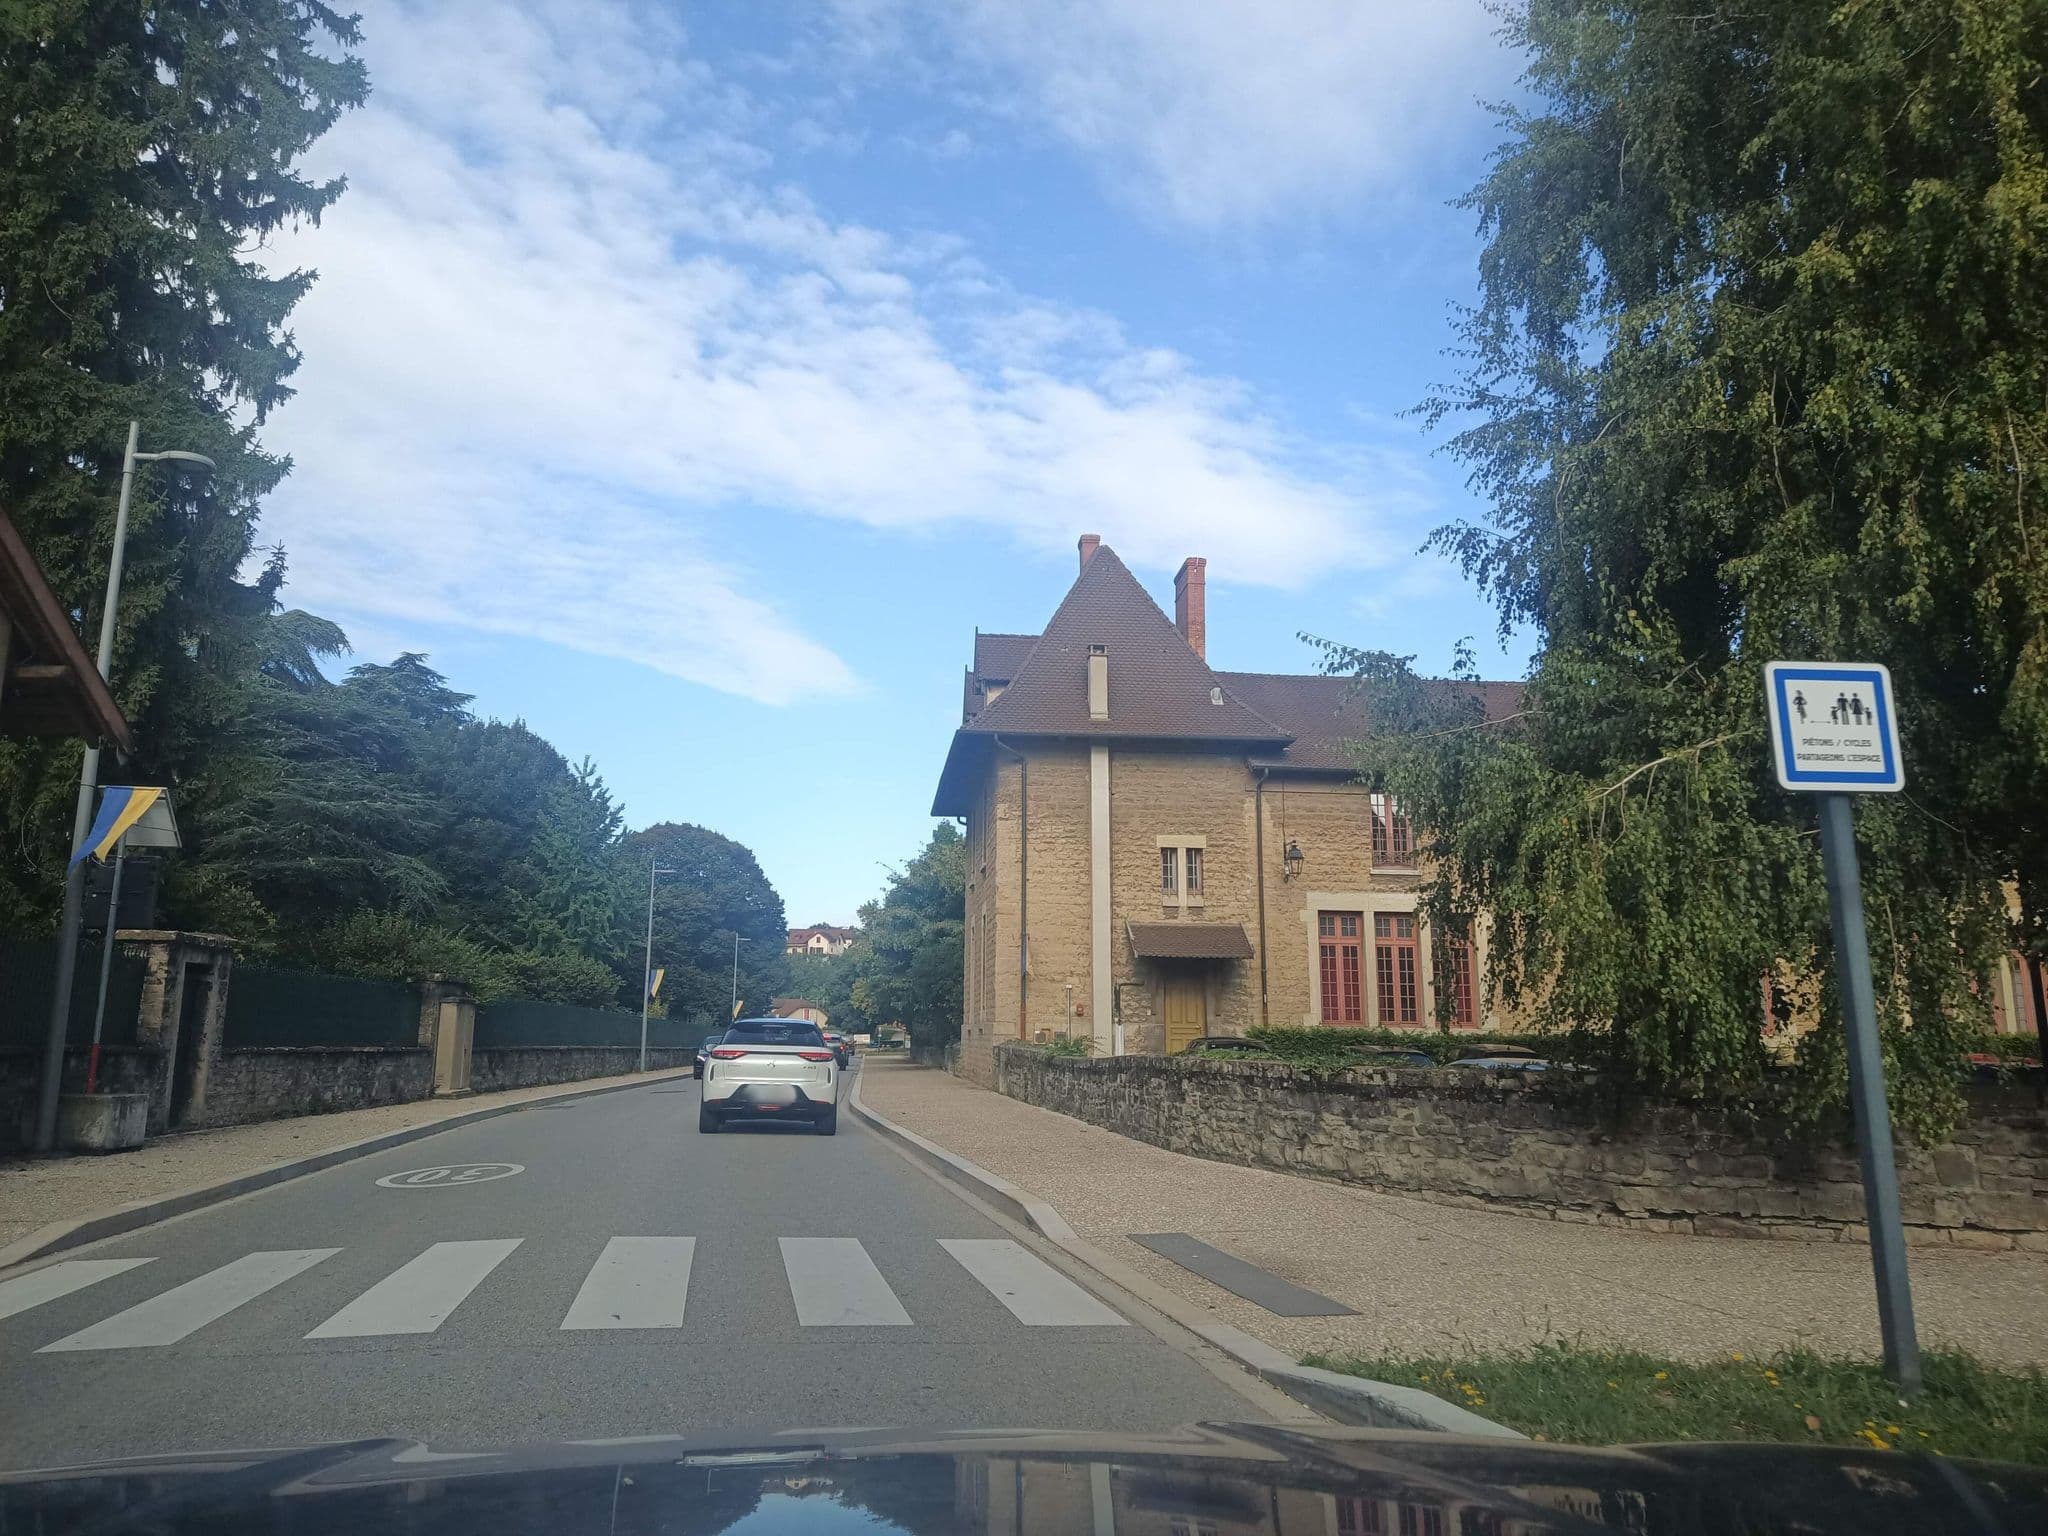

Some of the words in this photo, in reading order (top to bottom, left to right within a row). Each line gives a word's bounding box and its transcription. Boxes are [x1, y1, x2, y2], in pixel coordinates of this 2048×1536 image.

[1843, 739, 1872, 747] CYCLES
[1797, 753, 1845, 762] PARTAGEONS
[1847, 754, 1881, 763] L'ESPACE
[406, 1166, 499, 1183] 30
